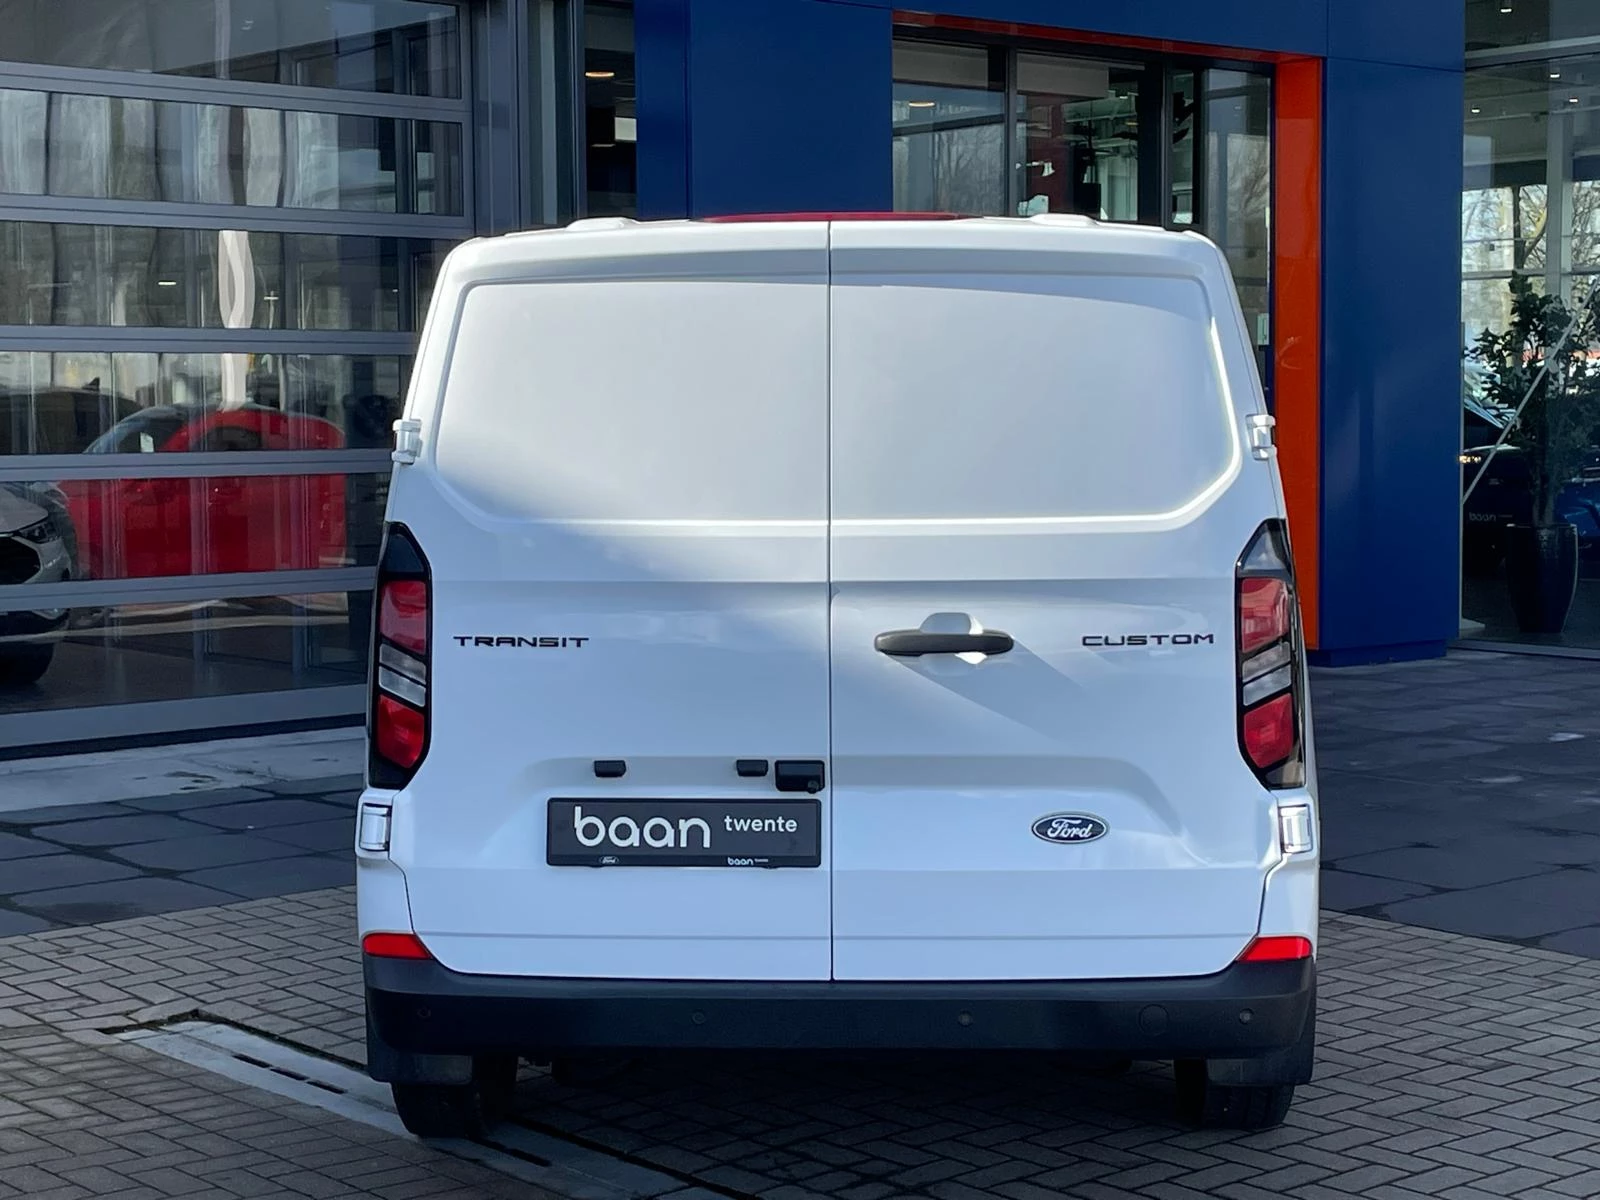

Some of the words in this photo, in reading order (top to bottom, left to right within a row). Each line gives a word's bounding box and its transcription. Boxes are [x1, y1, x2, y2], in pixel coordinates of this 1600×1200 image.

[453, 636, 590, 648] TRANSIT
[1082, 634, 1214, 646] CUSTOM
[574, 806, 711, 848] baan
[724, 815, 798, 832] twente
[1047, 818, 1093, 838] Ford
[728, 856, 754, 865] baan
